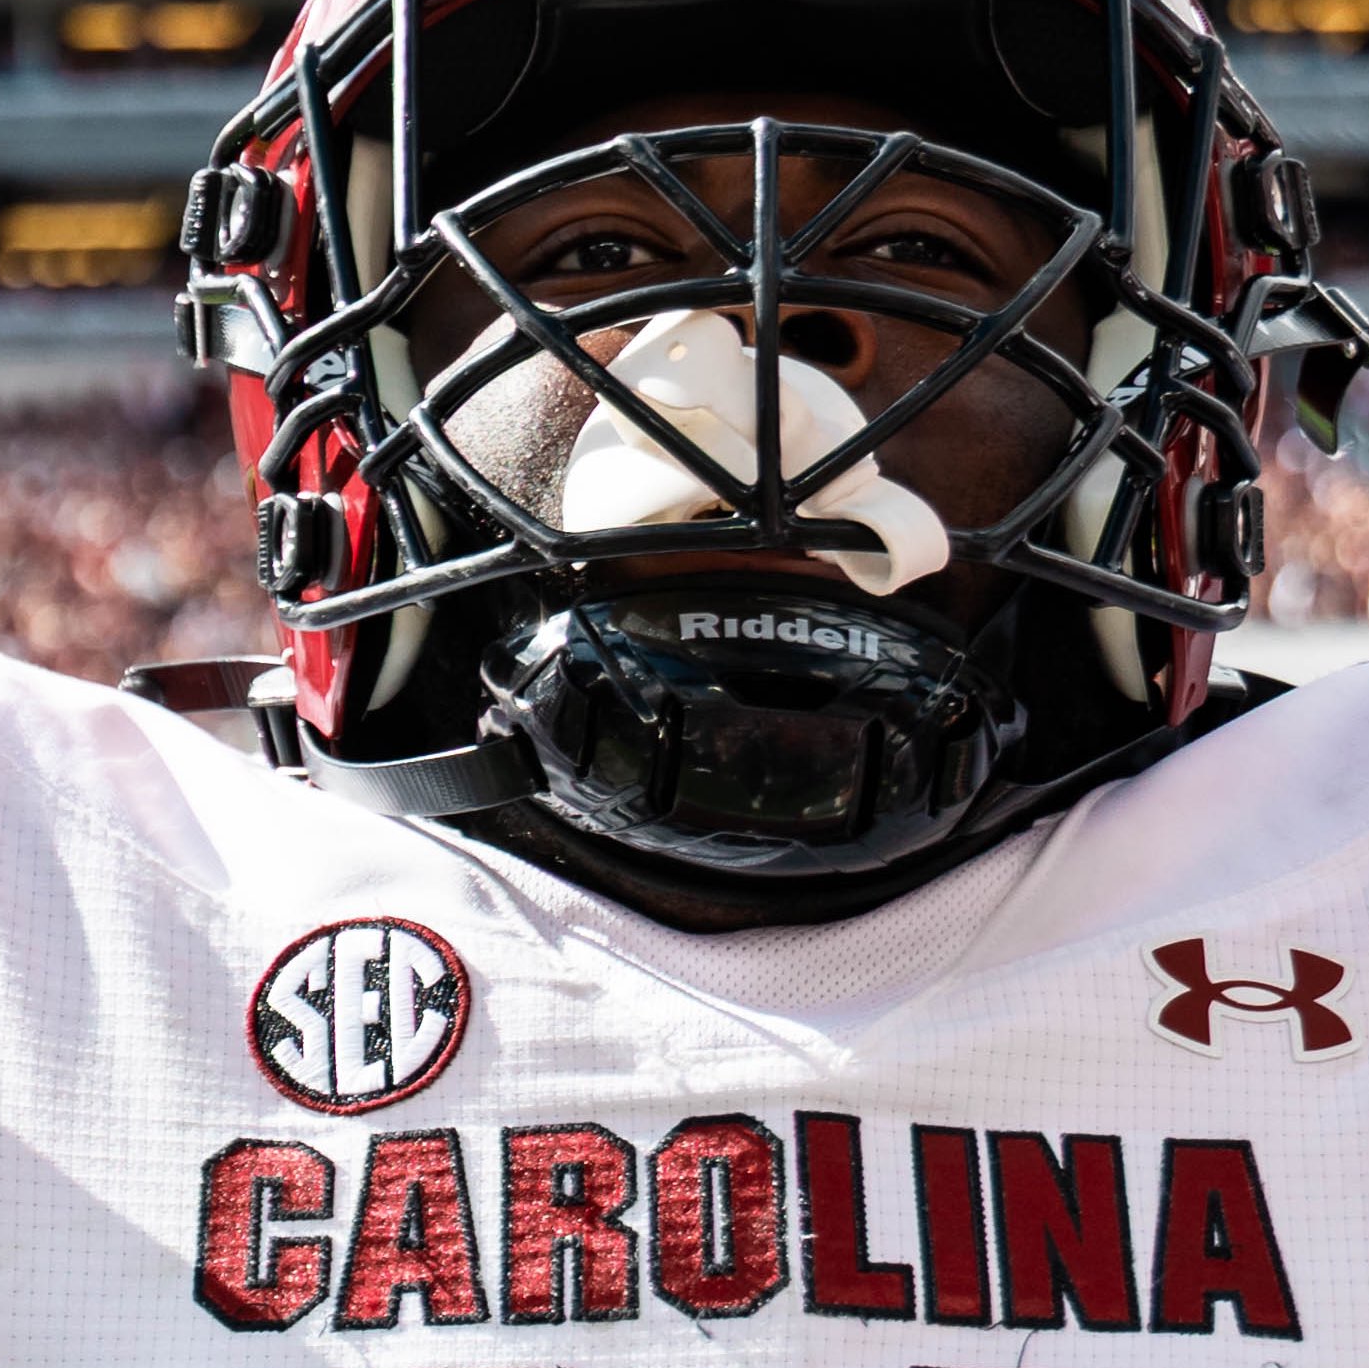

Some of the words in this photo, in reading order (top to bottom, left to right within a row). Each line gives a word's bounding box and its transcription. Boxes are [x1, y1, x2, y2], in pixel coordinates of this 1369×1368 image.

[679, 612, 879, 661] Riddell
[266, 928, 449, 1095] SEC
[194, 1110, 1301, 1341] CAROLINA
